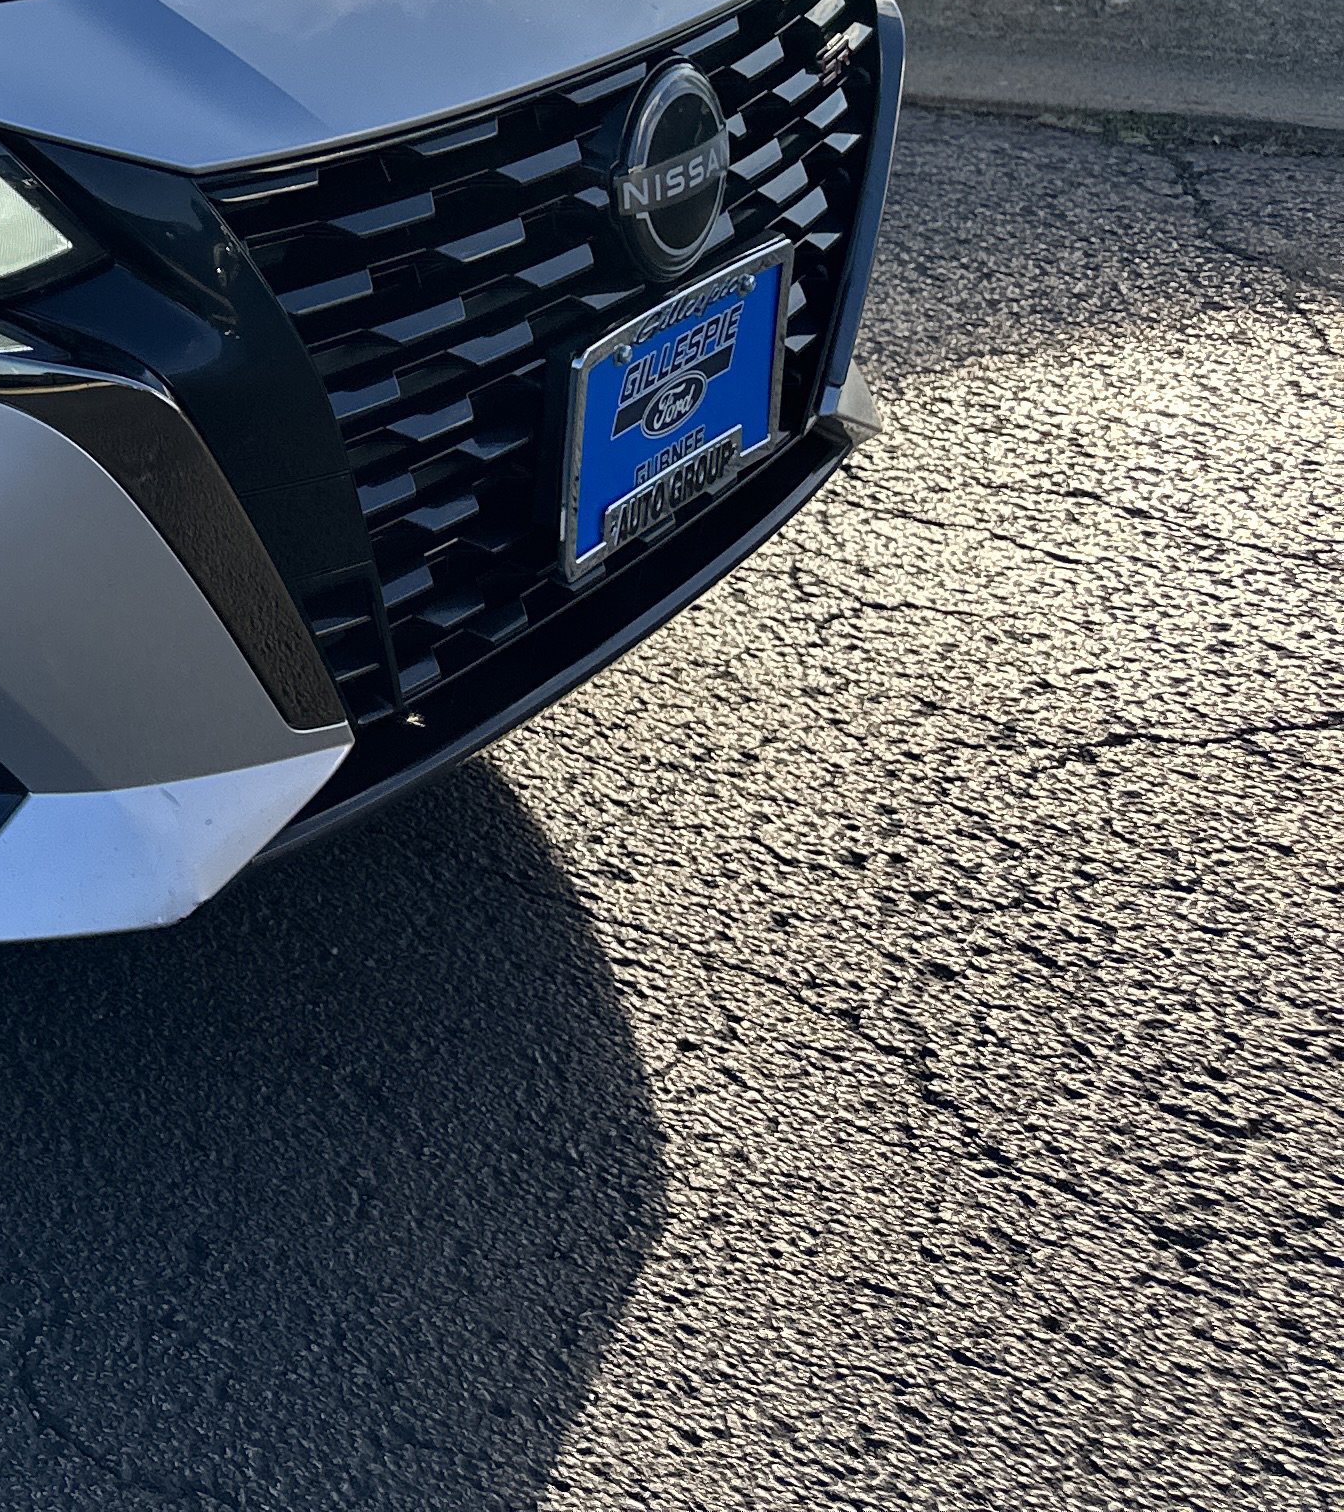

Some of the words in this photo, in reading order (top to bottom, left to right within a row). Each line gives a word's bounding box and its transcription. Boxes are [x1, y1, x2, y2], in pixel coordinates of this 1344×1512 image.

[618, 300, 745, 406] GILLESPIE
[652, 378, 695, 430] Ford
[615, 483, 664, 546] AUTO
[667, 439, 737, 503] GROUP
